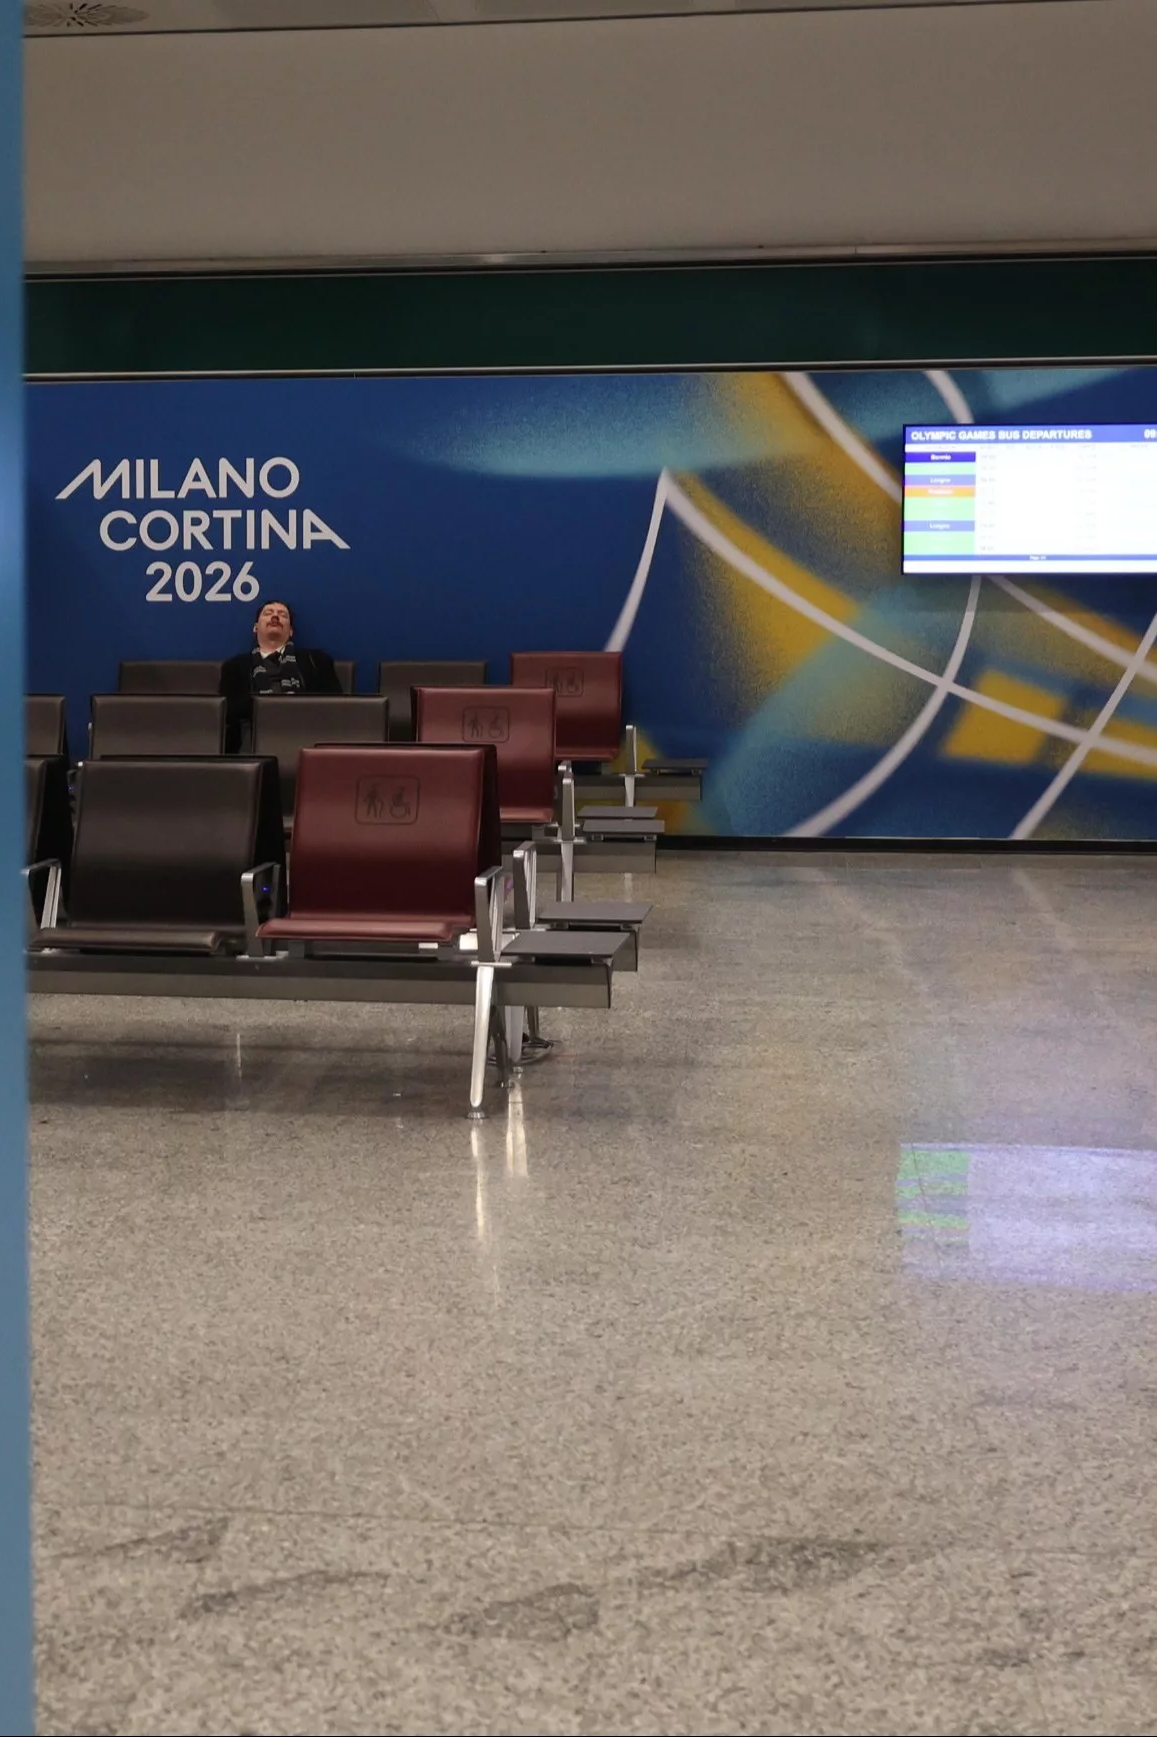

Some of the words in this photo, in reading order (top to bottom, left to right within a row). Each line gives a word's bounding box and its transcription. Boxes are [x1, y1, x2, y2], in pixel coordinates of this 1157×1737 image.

[911, 430, 956, 441] OLYMPIC
[958, 430, 996, 440] GAMES
[998, 430, 1020, 440] BUS
[1022, 429, 1092, 440] DEPARTURES
[55, 456, 300, 500] MILANO
[99, 508, 351, 551] CORTINA
[145, 560, 260, 602] 2026
